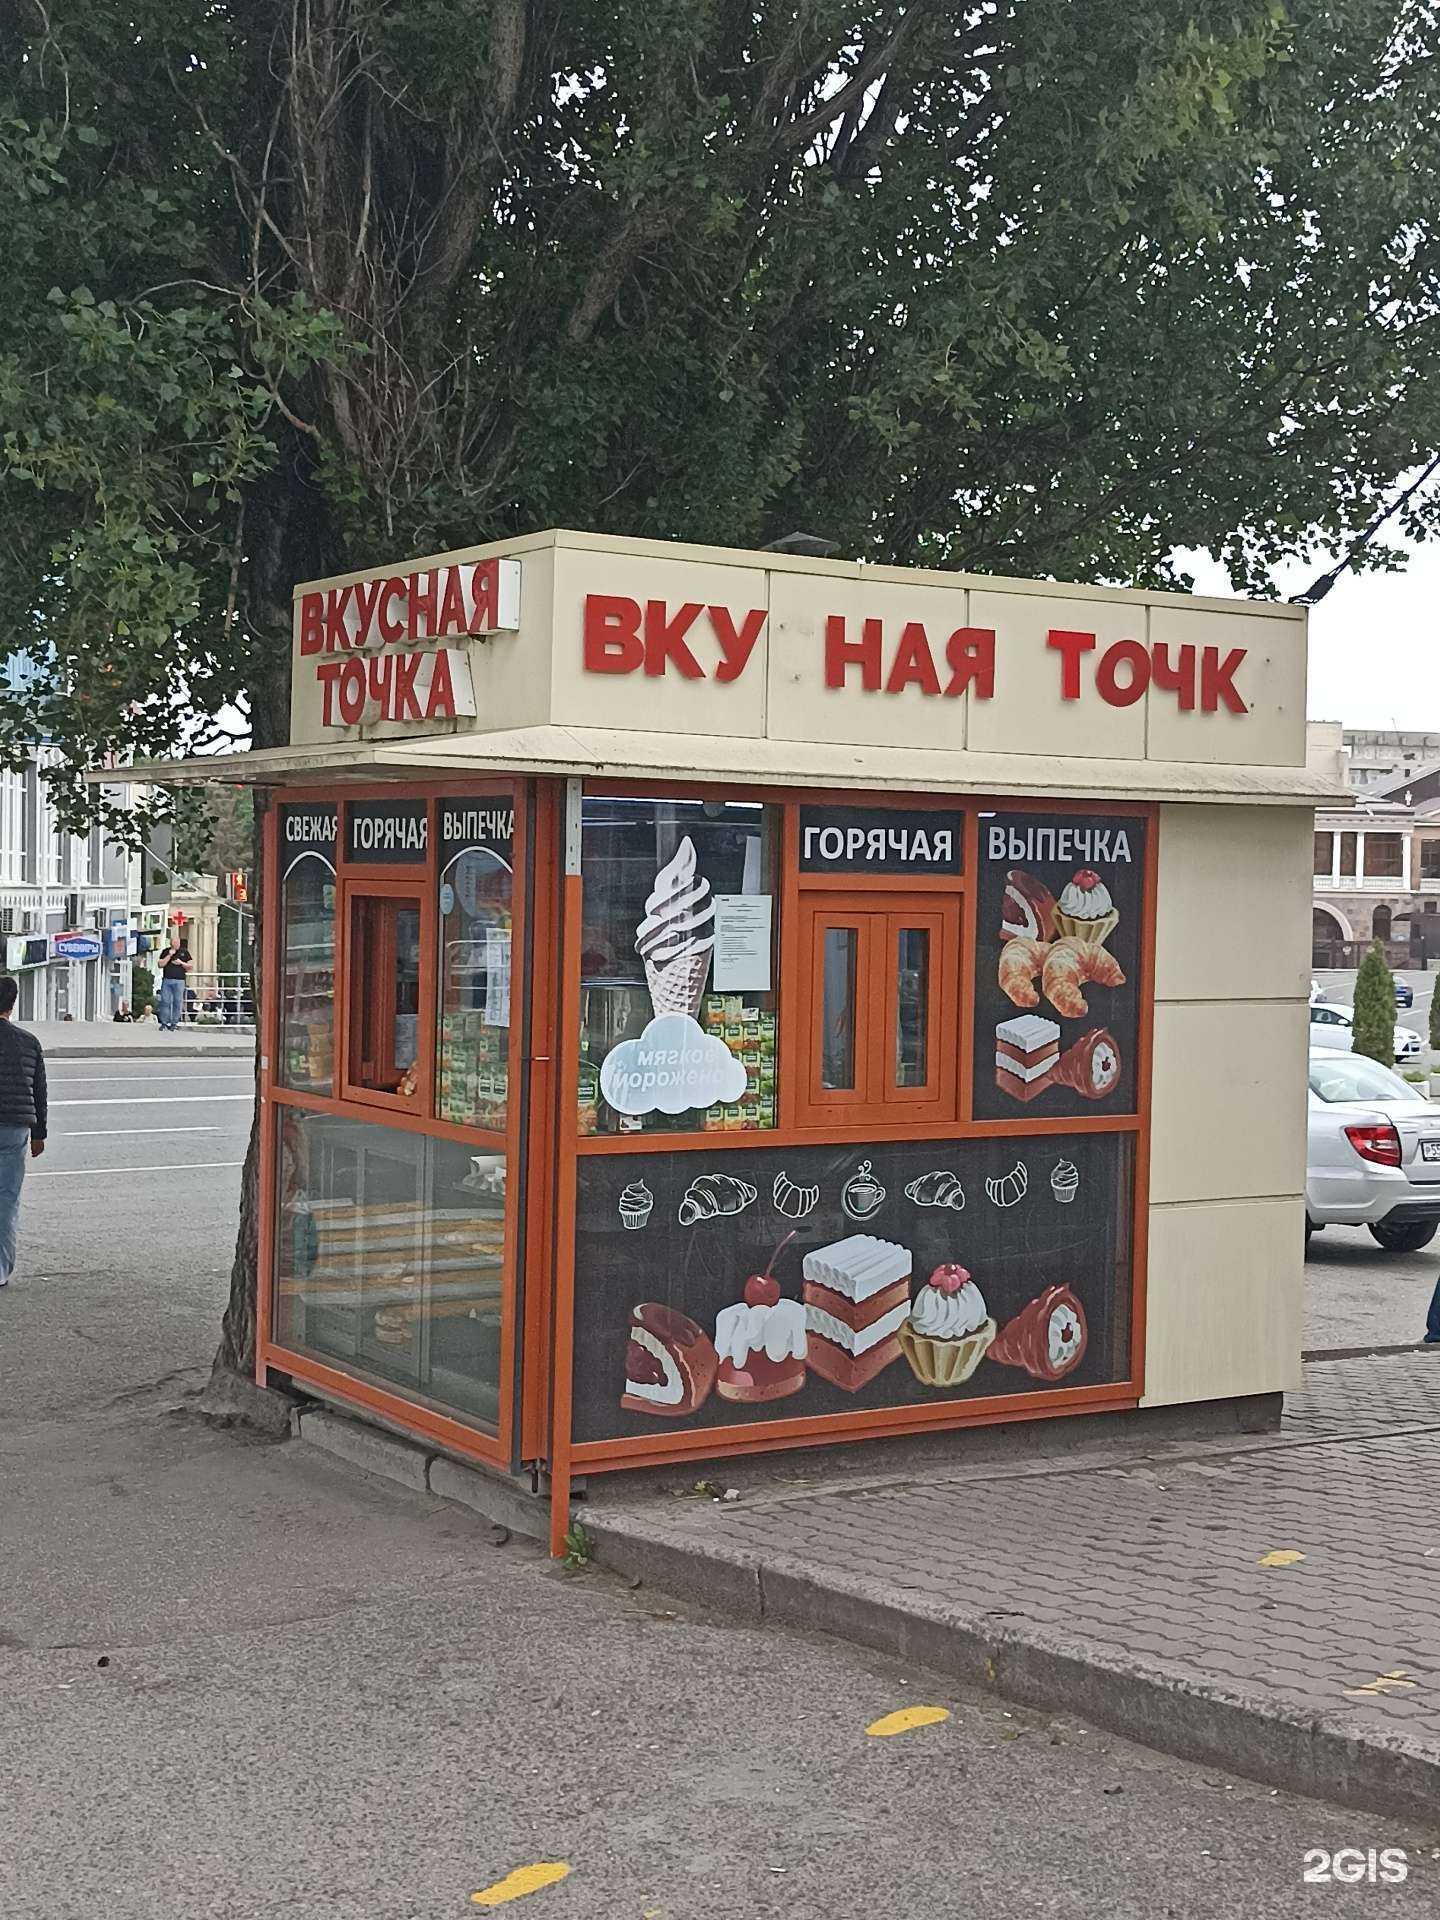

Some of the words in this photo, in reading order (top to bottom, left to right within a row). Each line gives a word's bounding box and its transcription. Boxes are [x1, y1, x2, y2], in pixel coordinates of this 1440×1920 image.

[301, 559, 500, 656] ВКУСНАЯ
[317, 649, 456, 726] ТОЧКА
[584, 595, 768, 680] ВКУ
[825, 615, 996, 699] НАЯ
[1047, 629, 1249, 713] ТОЧК
[353, 818, 428, 849] ГОРЯЧАЯ
[443, 809, 515, 840] ВЫПЕЧКА
[804, 827, 952, 861] ГОРЯЧАЯ
[989, 827, 1131, 863] ВЫПЕЧКА
